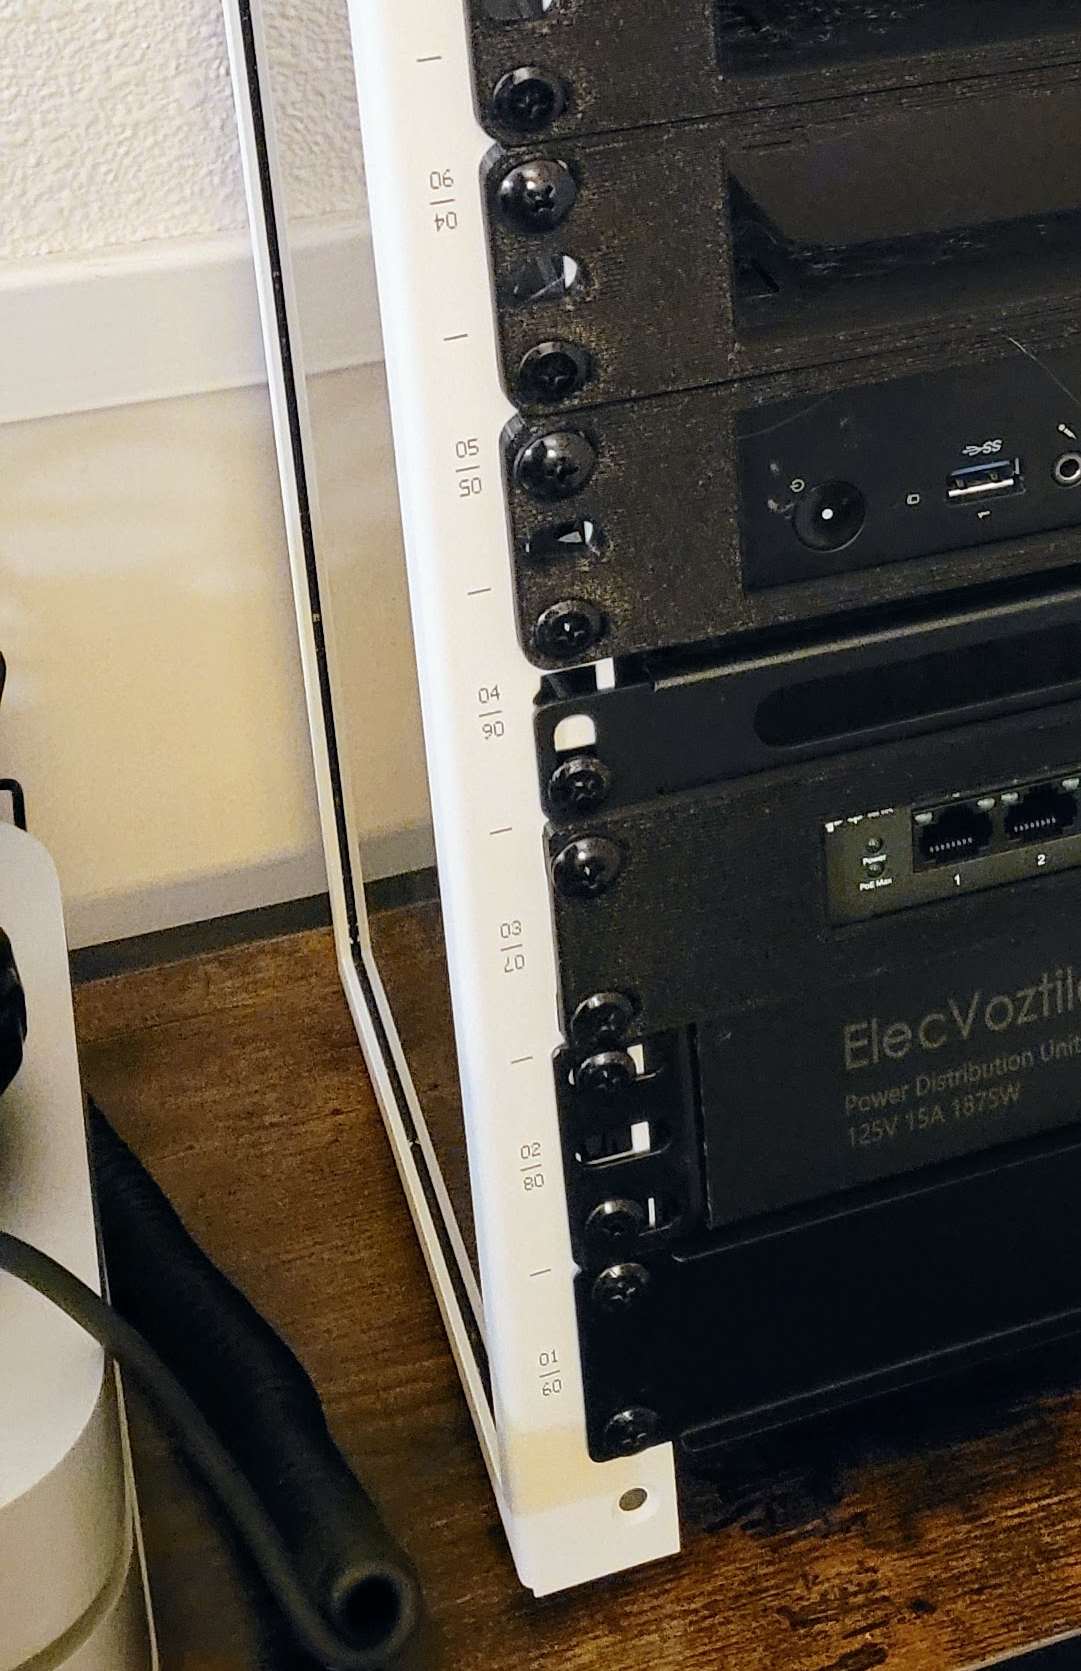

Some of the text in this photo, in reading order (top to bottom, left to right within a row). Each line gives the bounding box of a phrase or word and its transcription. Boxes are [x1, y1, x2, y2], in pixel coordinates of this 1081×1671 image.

[954, 874, 961, 886] 1
[1037, 854, 1046, 865] 2
[845, 1084, 909, 1114] Power
[915, 1049, 1034, 1097] Distribution
[849, 1081, 1025, 1147] 125V 15A 1875W
